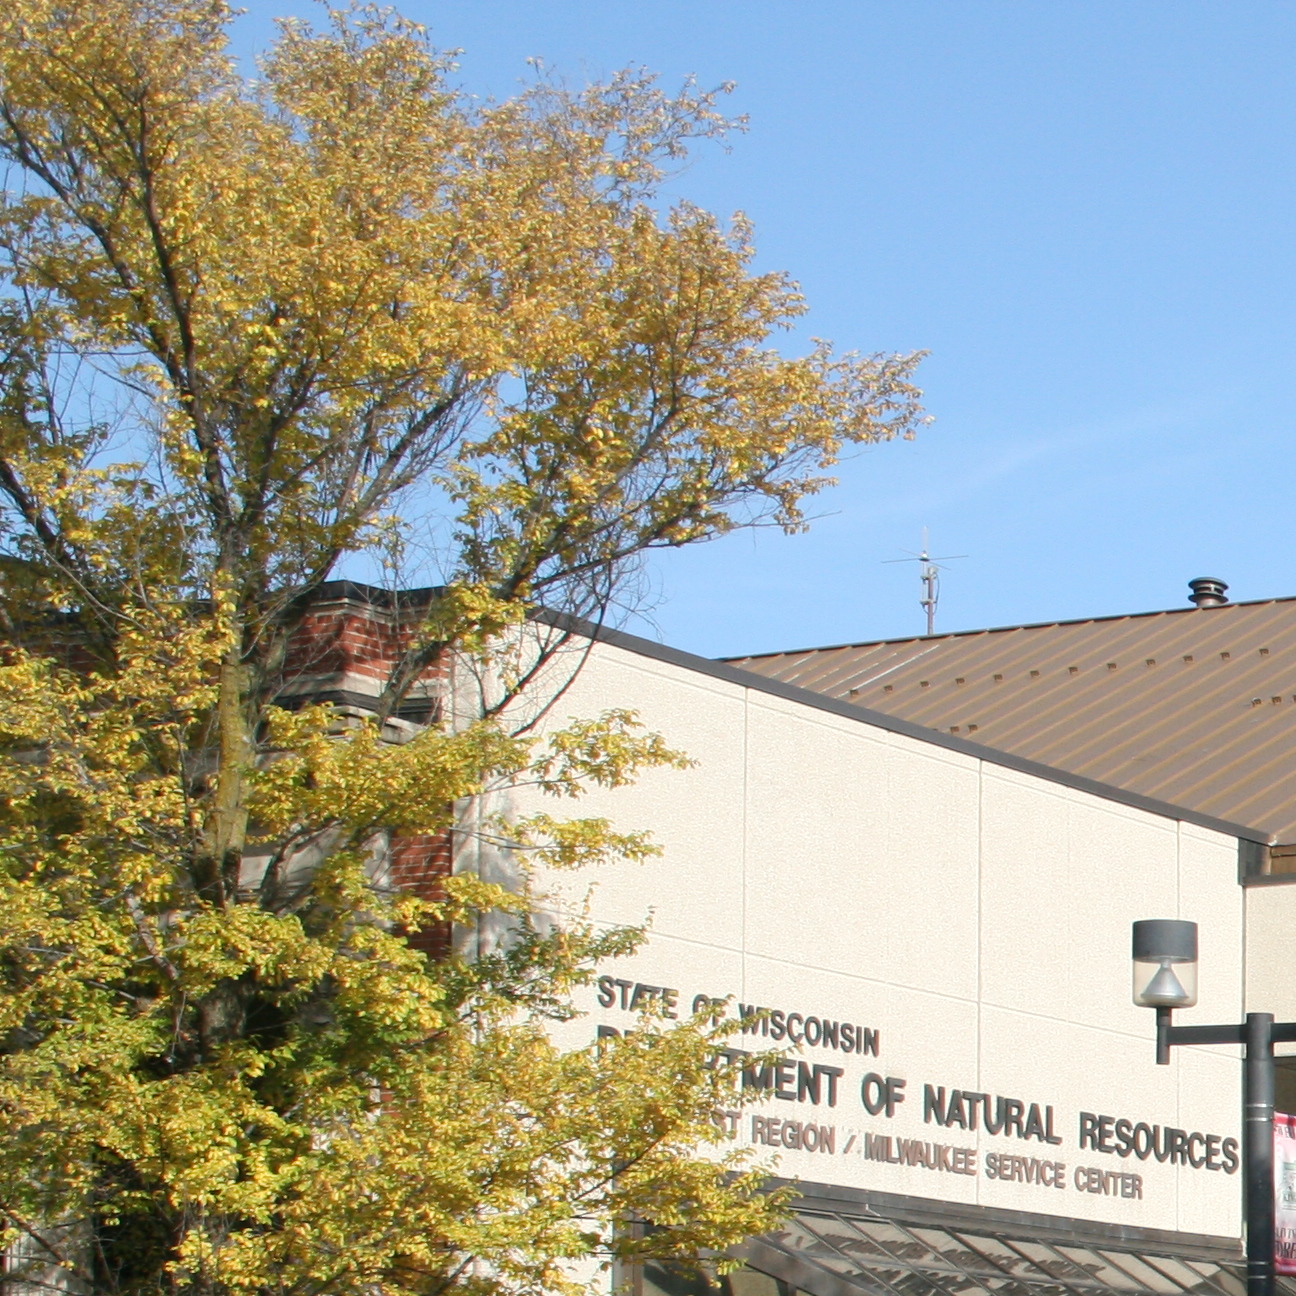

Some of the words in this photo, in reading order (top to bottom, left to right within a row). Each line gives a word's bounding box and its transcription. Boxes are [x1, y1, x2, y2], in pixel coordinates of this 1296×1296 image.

[597, 975, 679, 1020] STATE
[692, 993, 727, 1028] OF
[738, 1003, 880, 1057] WISCONSIN
[752, 1114, 836, 1155] REGION
[843, 1133, 857, 1154] /
[864, 1132, 977, 1176] MILWAUKEE
[985, 1151, 1066, 1189] SERVICE
[1074, 1165, 1143, 1200] CENTER
[861, 1072, 907, 1118] OF
[923, 1083, 1062, 1146] NATURAL
[1079, 1111, 1240, 1175] RESOURCES
